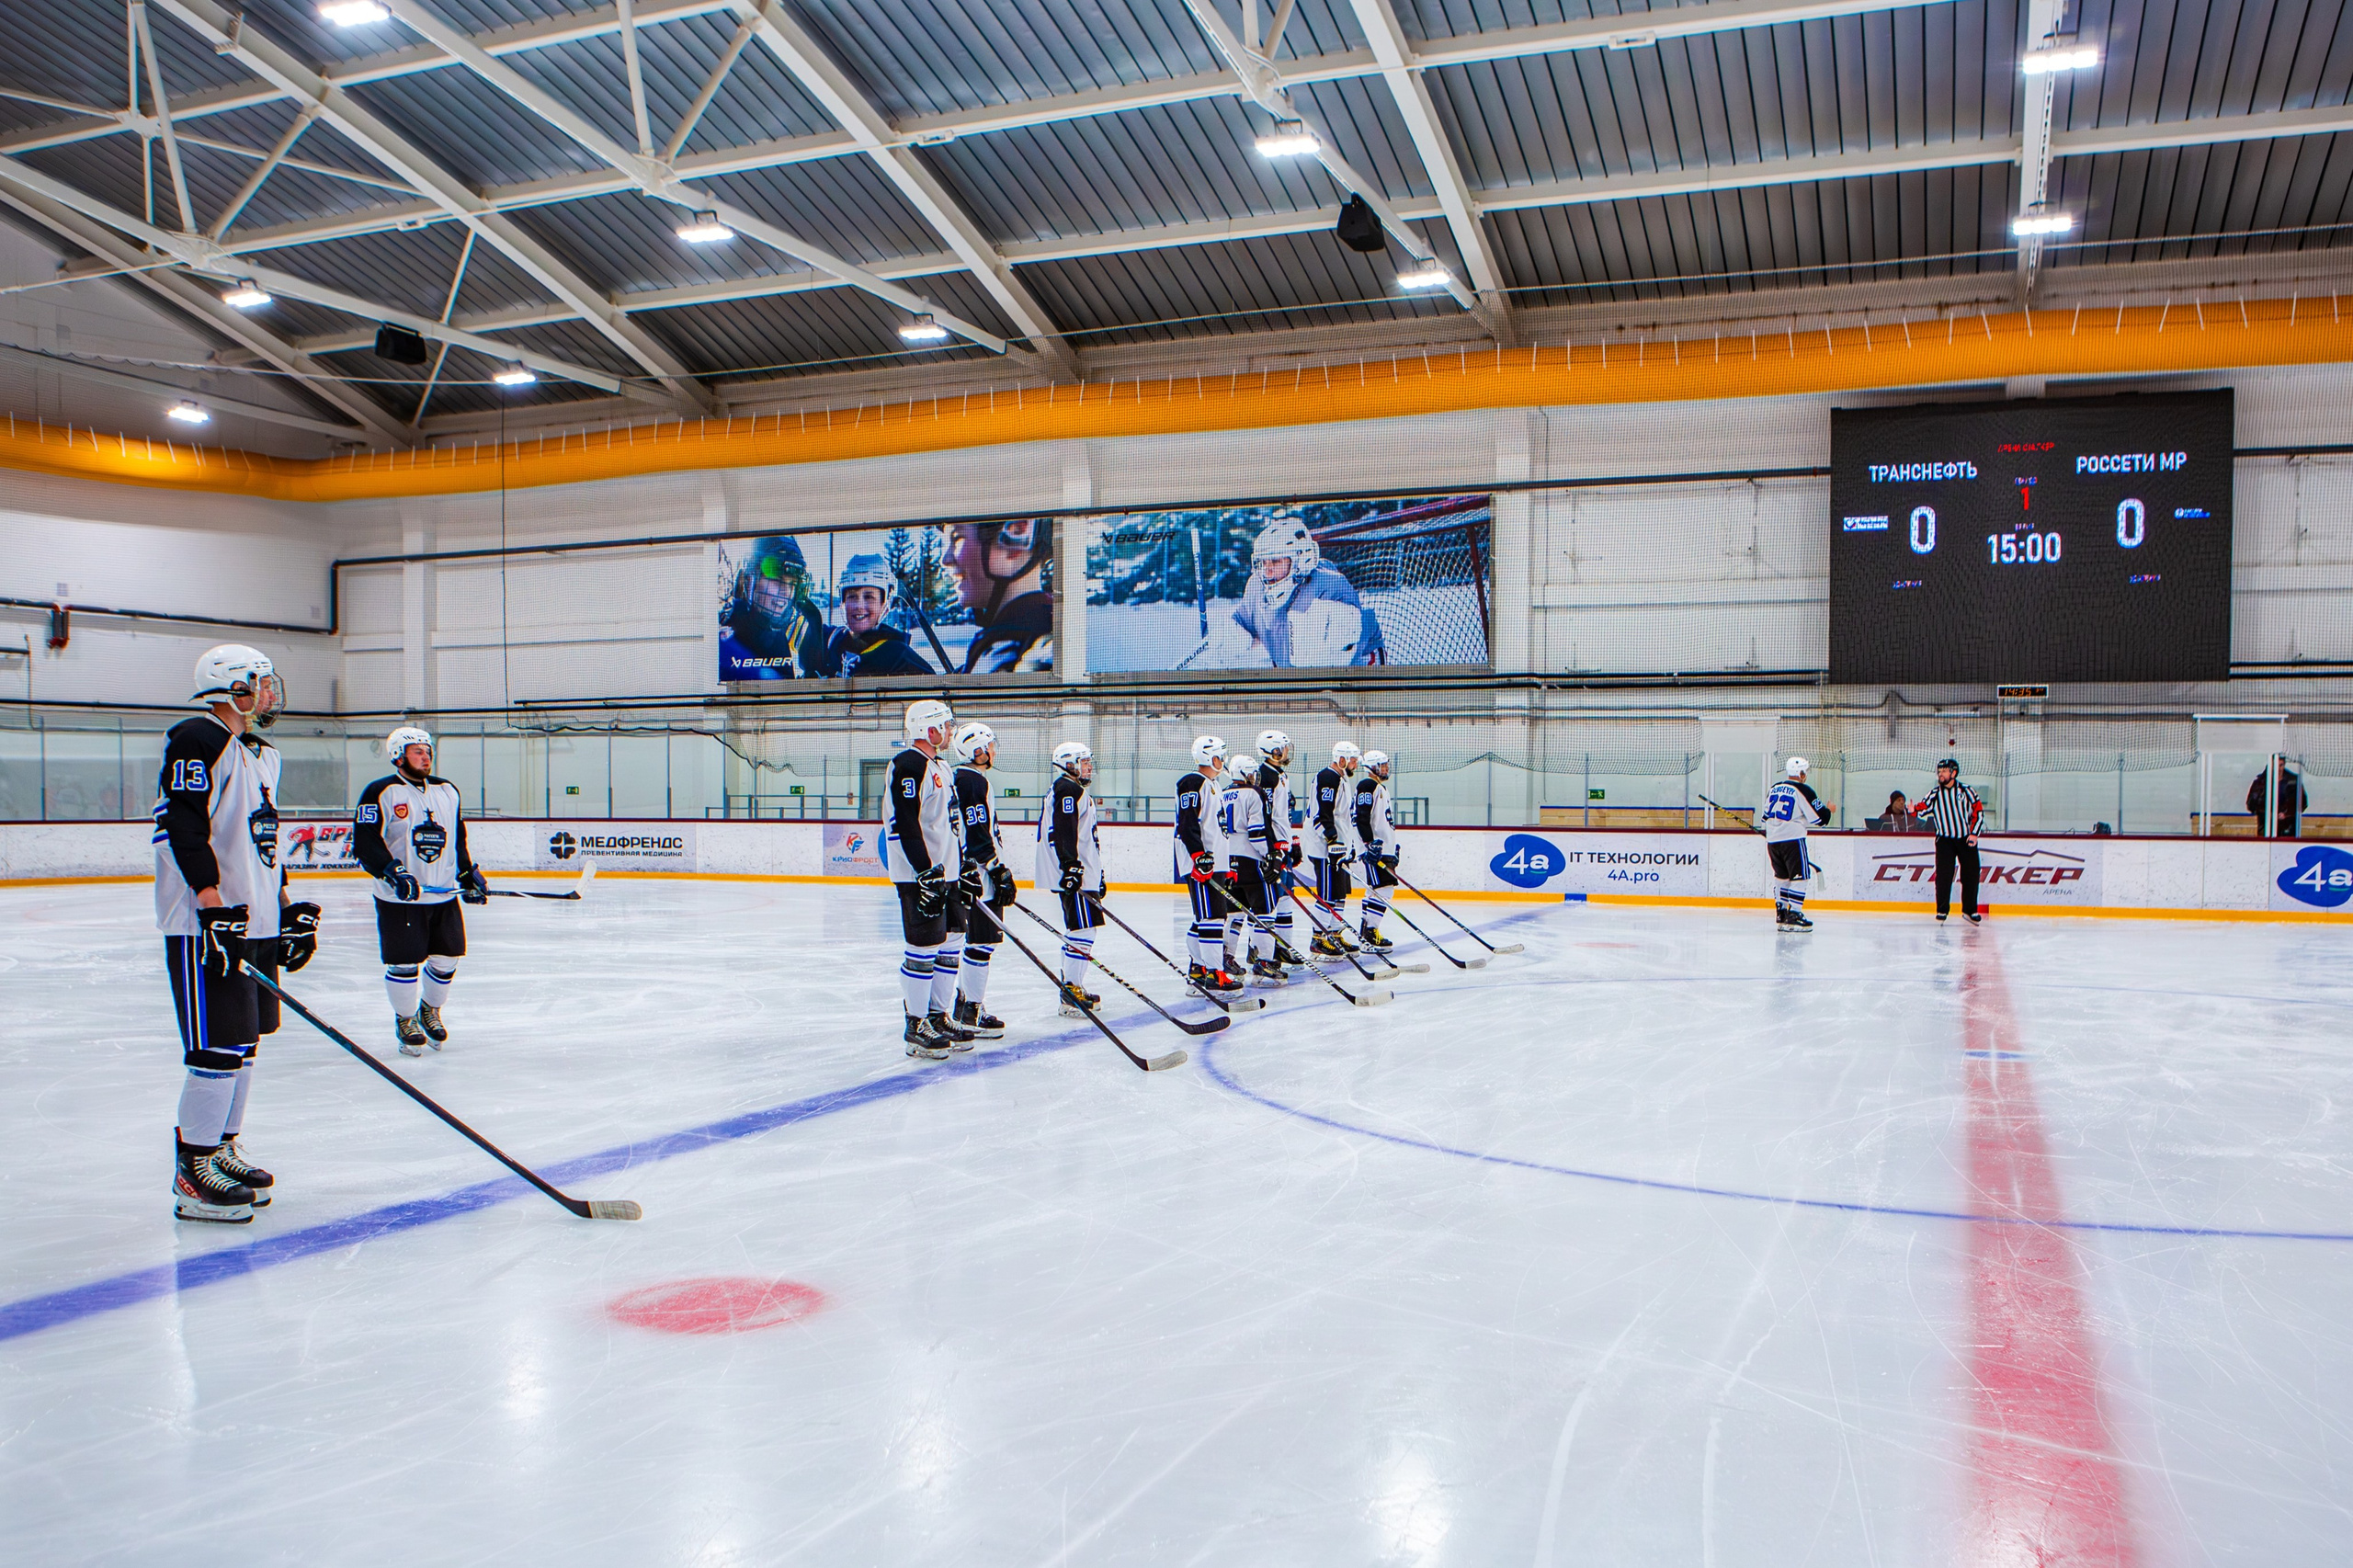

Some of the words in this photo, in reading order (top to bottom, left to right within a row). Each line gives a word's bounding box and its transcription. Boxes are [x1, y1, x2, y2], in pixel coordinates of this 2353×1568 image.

[1869, 461, 1978, 483] ТРАНСНЕФТЬ
[2076, 454, 2154, 474] РОССЕТИ
[2160, 451, 2188, 472] МР
[2020, 487, 2029, 510] 1
[1909, 506, 1937, 554] 0
[2116, 498, 2145, 549] 0
[1987, 532, 2062, 564] 15:00
[171, 759, 209, 790] 13
[902, 778, 915, 798] 3
[1322, 788, 1334, 801] 21
[1063, 797, 1074, 813] 8
[1180, 791, 1199, 809] 87
[357, 804, 378, 824] 15
[966, 804, 987, 825] 33
[581, 835, 683, 849] МЕДФРЕНДС
[1587, 852, 1699, 866] ТЕХНОЛОГИИ
[1608, 869, 1659, 883] 4A.pro
[1873, 864, 2086, 885] СТКЕР
